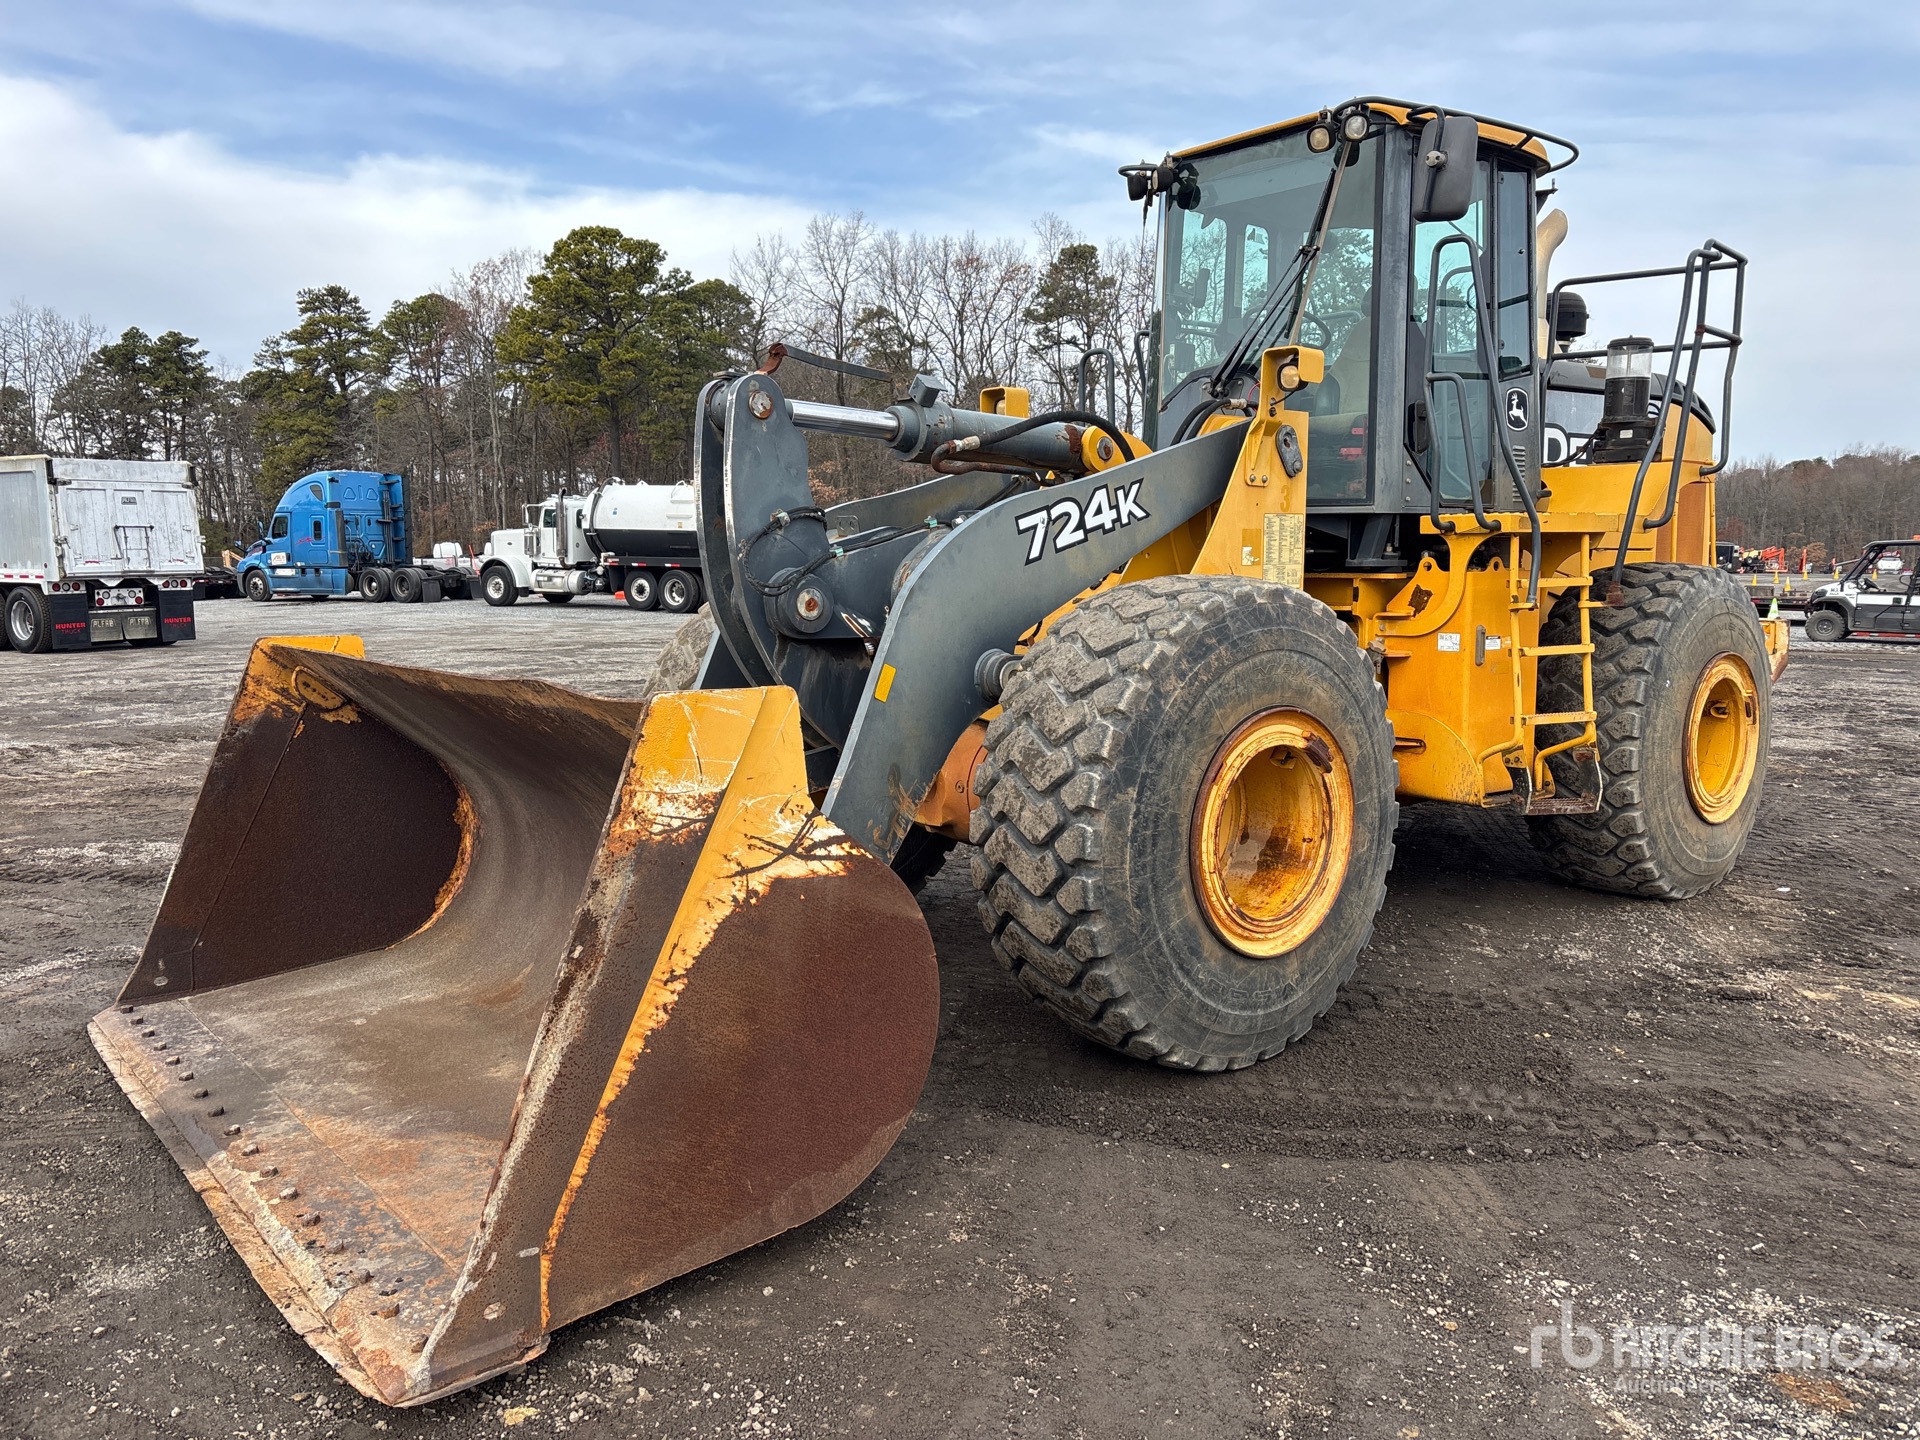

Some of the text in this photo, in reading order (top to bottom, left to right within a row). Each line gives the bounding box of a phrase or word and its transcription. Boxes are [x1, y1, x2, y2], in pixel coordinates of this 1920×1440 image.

[1015, 478, 1150, 565] 724K
[163, 616, 192, 624] HUNTER
[55, 622, 86, 630] HUNTER
